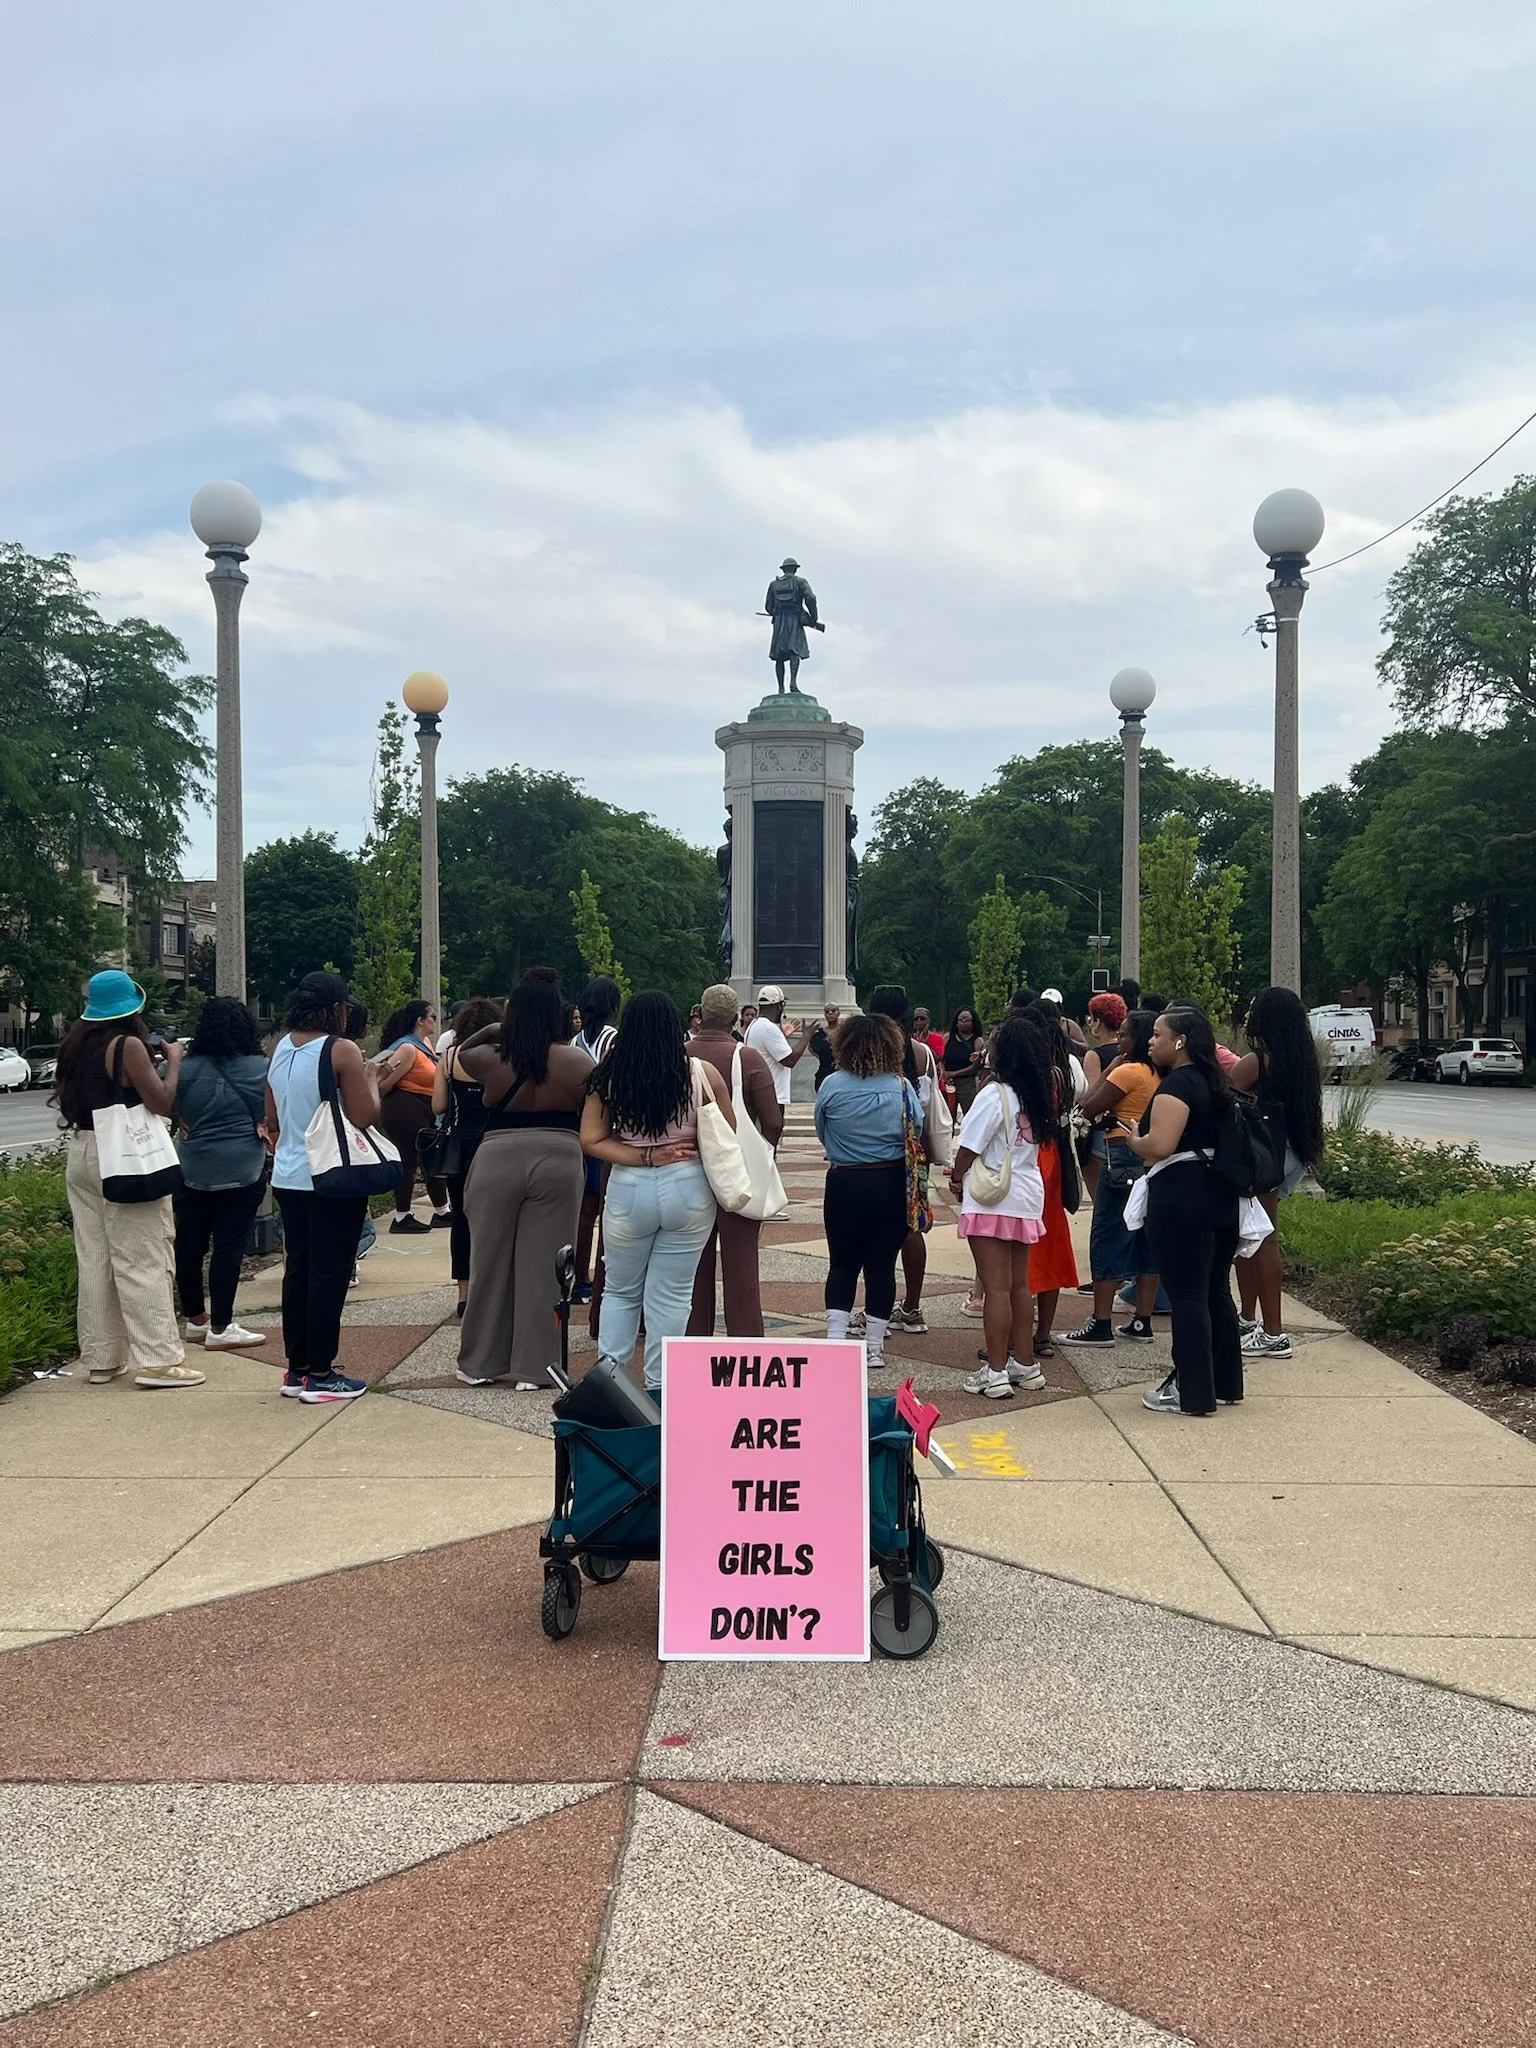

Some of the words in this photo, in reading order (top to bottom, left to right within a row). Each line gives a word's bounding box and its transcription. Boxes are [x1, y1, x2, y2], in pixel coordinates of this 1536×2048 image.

[762, 785, 815, 797] VICTORY
[710, 1356, 808, 1388] WHAT
[730, 1417, 802, 1450] ARE
[732, 1480, 801, 1512] THE
[718, 1542, 814, 1576] GIRLS
[710, 1604, 821, 1641] DOIN'?
